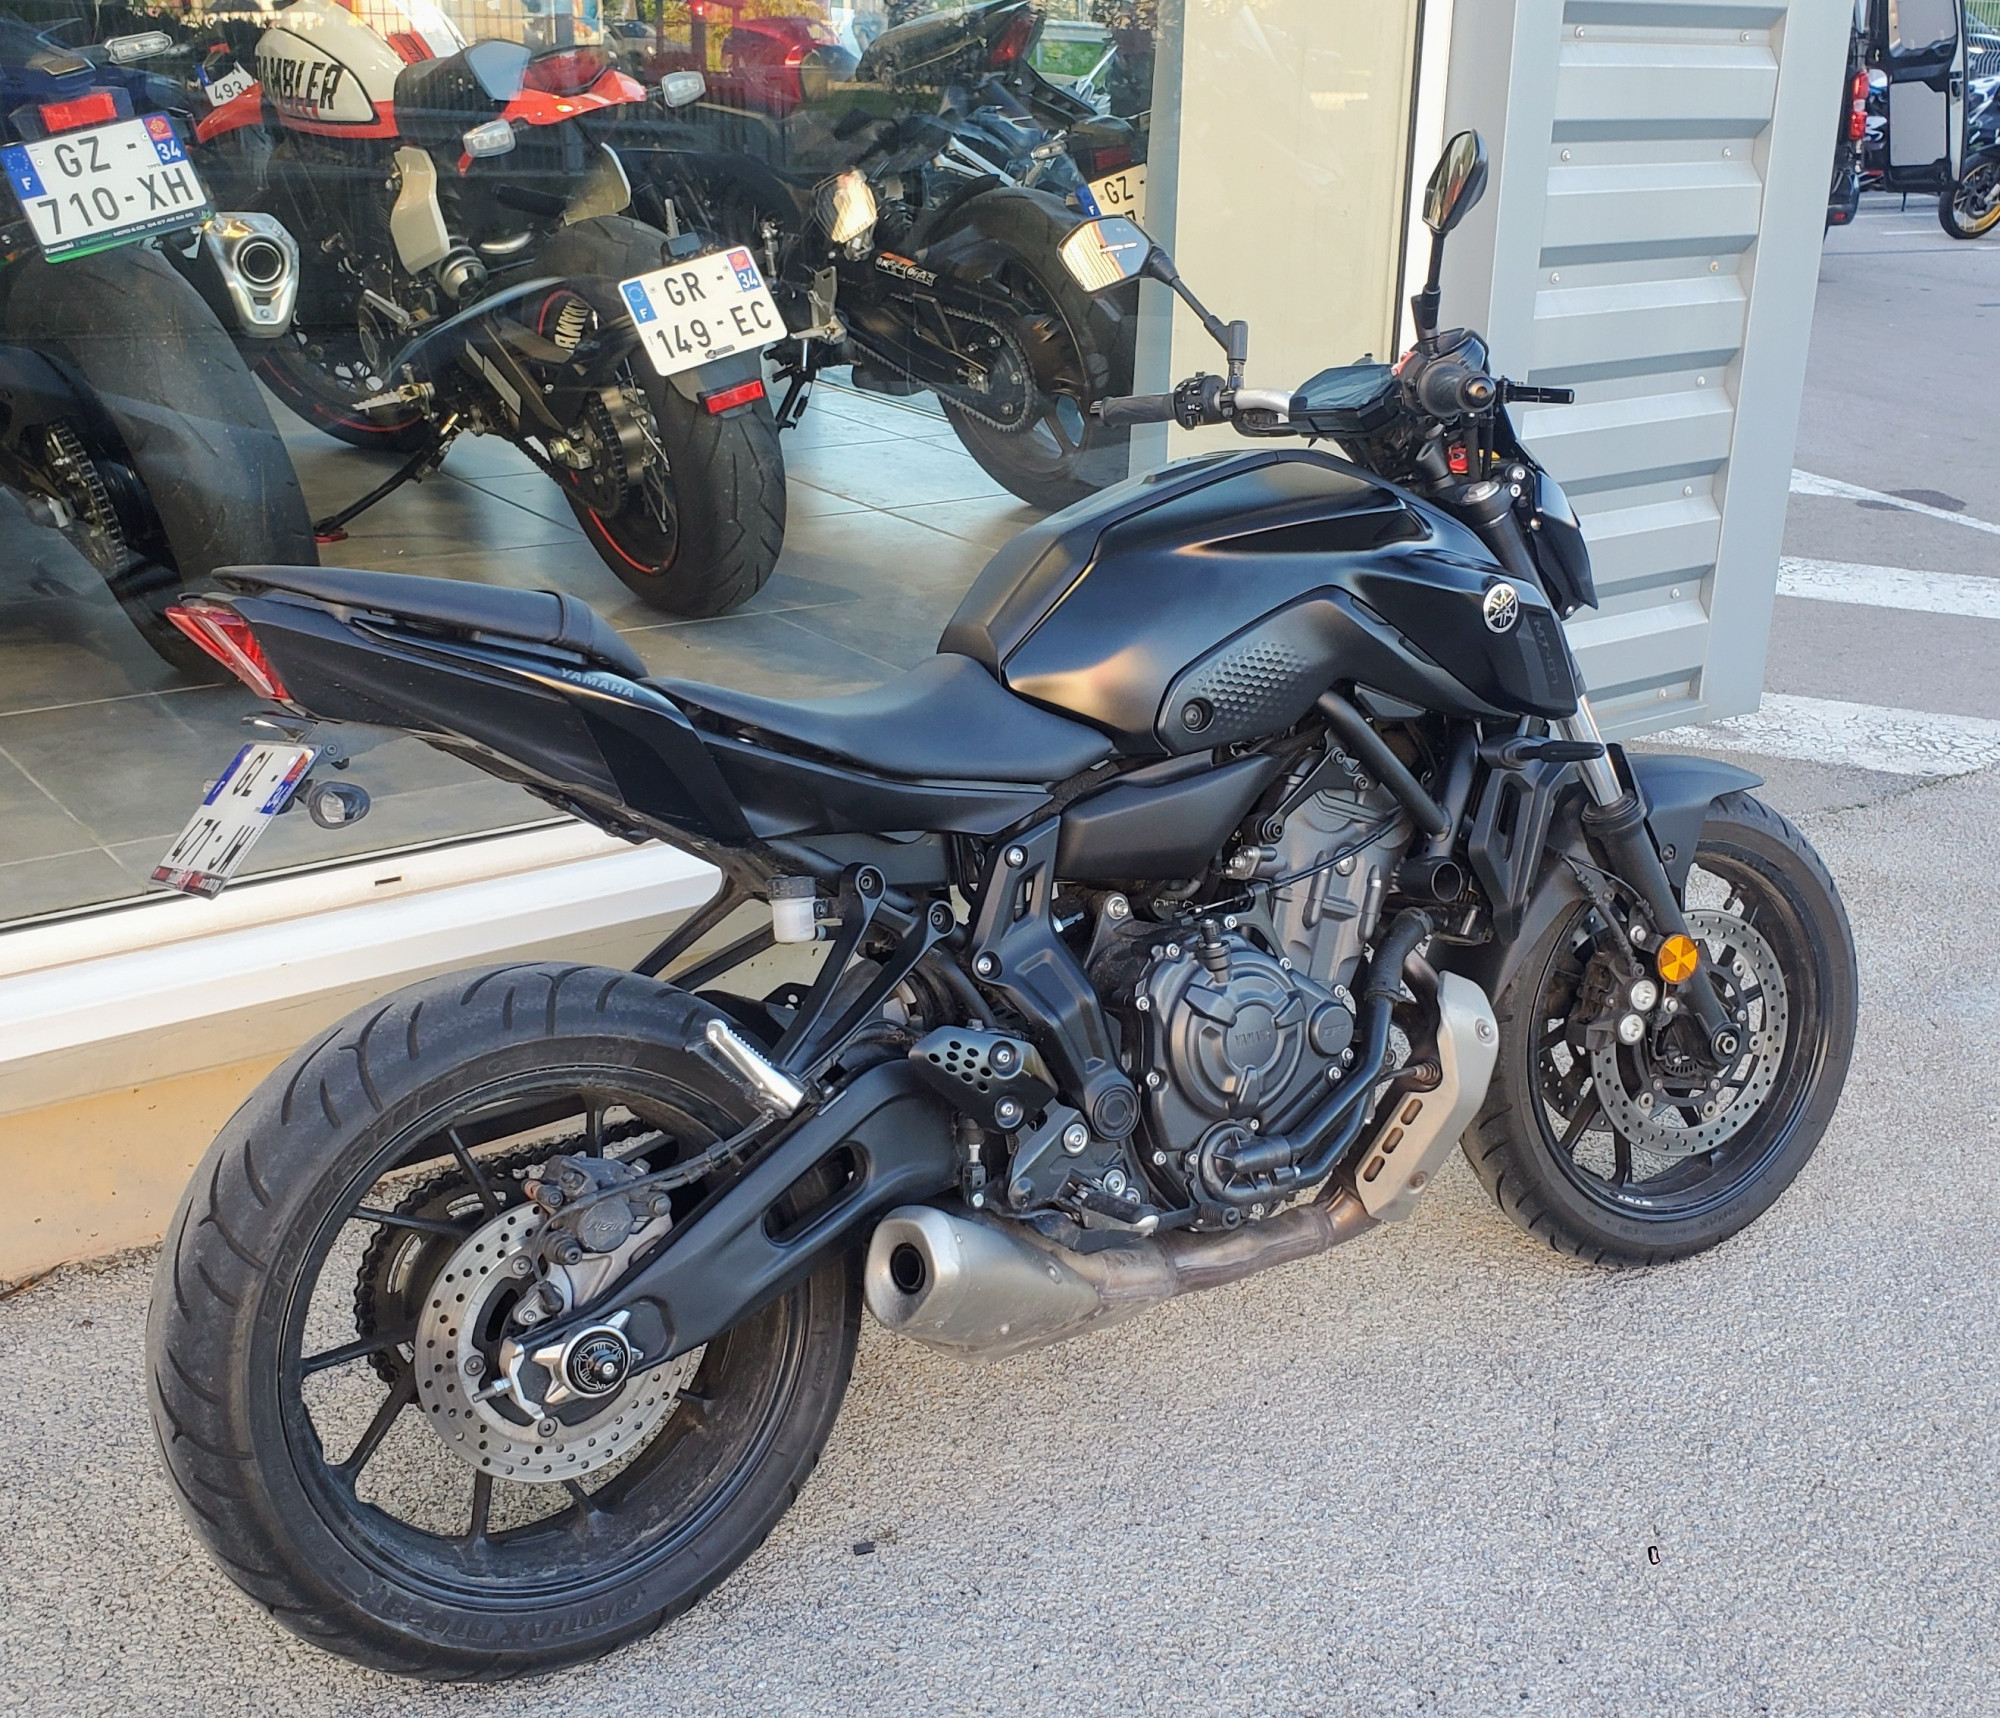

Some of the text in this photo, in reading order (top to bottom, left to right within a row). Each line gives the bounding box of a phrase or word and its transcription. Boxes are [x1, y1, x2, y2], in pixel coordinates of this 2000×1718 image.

[54, 136, 112, 178] GZ
[157, 140, 182, 160] 34
[21, 177, 32, 191] F
[1104, 176, 1134, 204] GZ
[36, 167, 195, 235] 710-XH
[1088, 205, 1095, 216] F
[663, 272, 707, 306] GR
[738, 269, 759, 289] 34
[639, 308, 648, 320] F
[656, 301, 772, 359] 149-EC
[561, 667, 635, 698] YAMAHA
[232, 751, 274, 797] GL
[267, 785, 288, 806] 34
